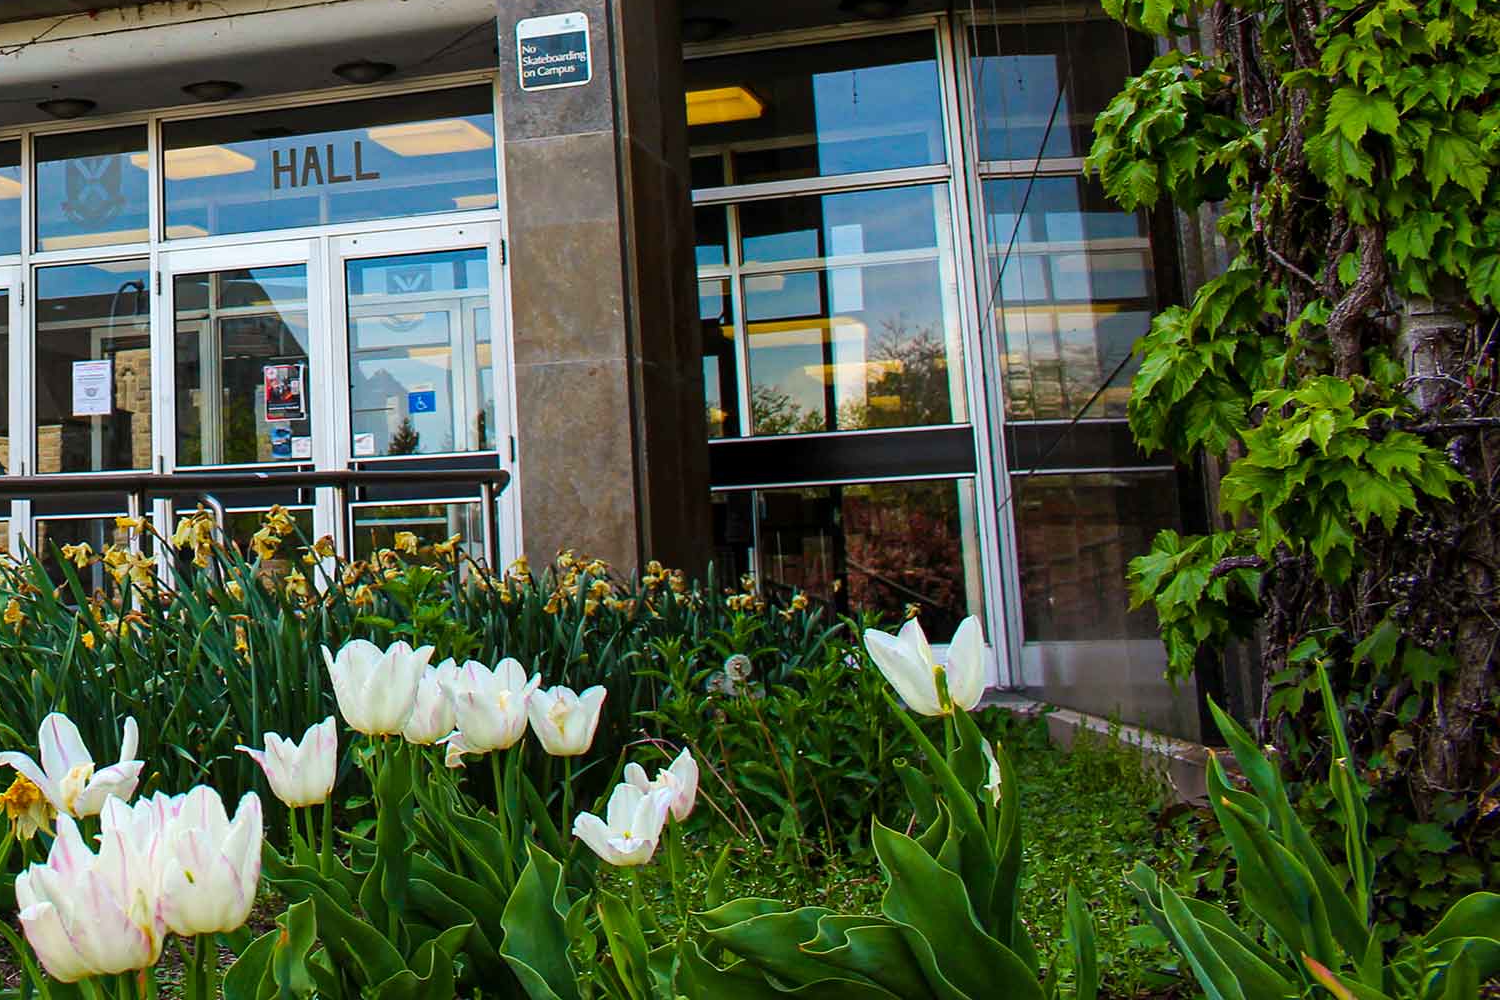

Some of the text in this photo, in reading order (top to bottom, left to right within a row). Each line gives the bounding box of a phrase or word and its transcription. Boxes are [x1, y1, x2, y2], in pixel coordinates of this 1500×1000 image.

[522, 45, 536, 54] No
[523, 50, 587, 66] Skateboarding
[523, 64, 576, 78] on Campus
[272, 140, 381, 190] HALL
